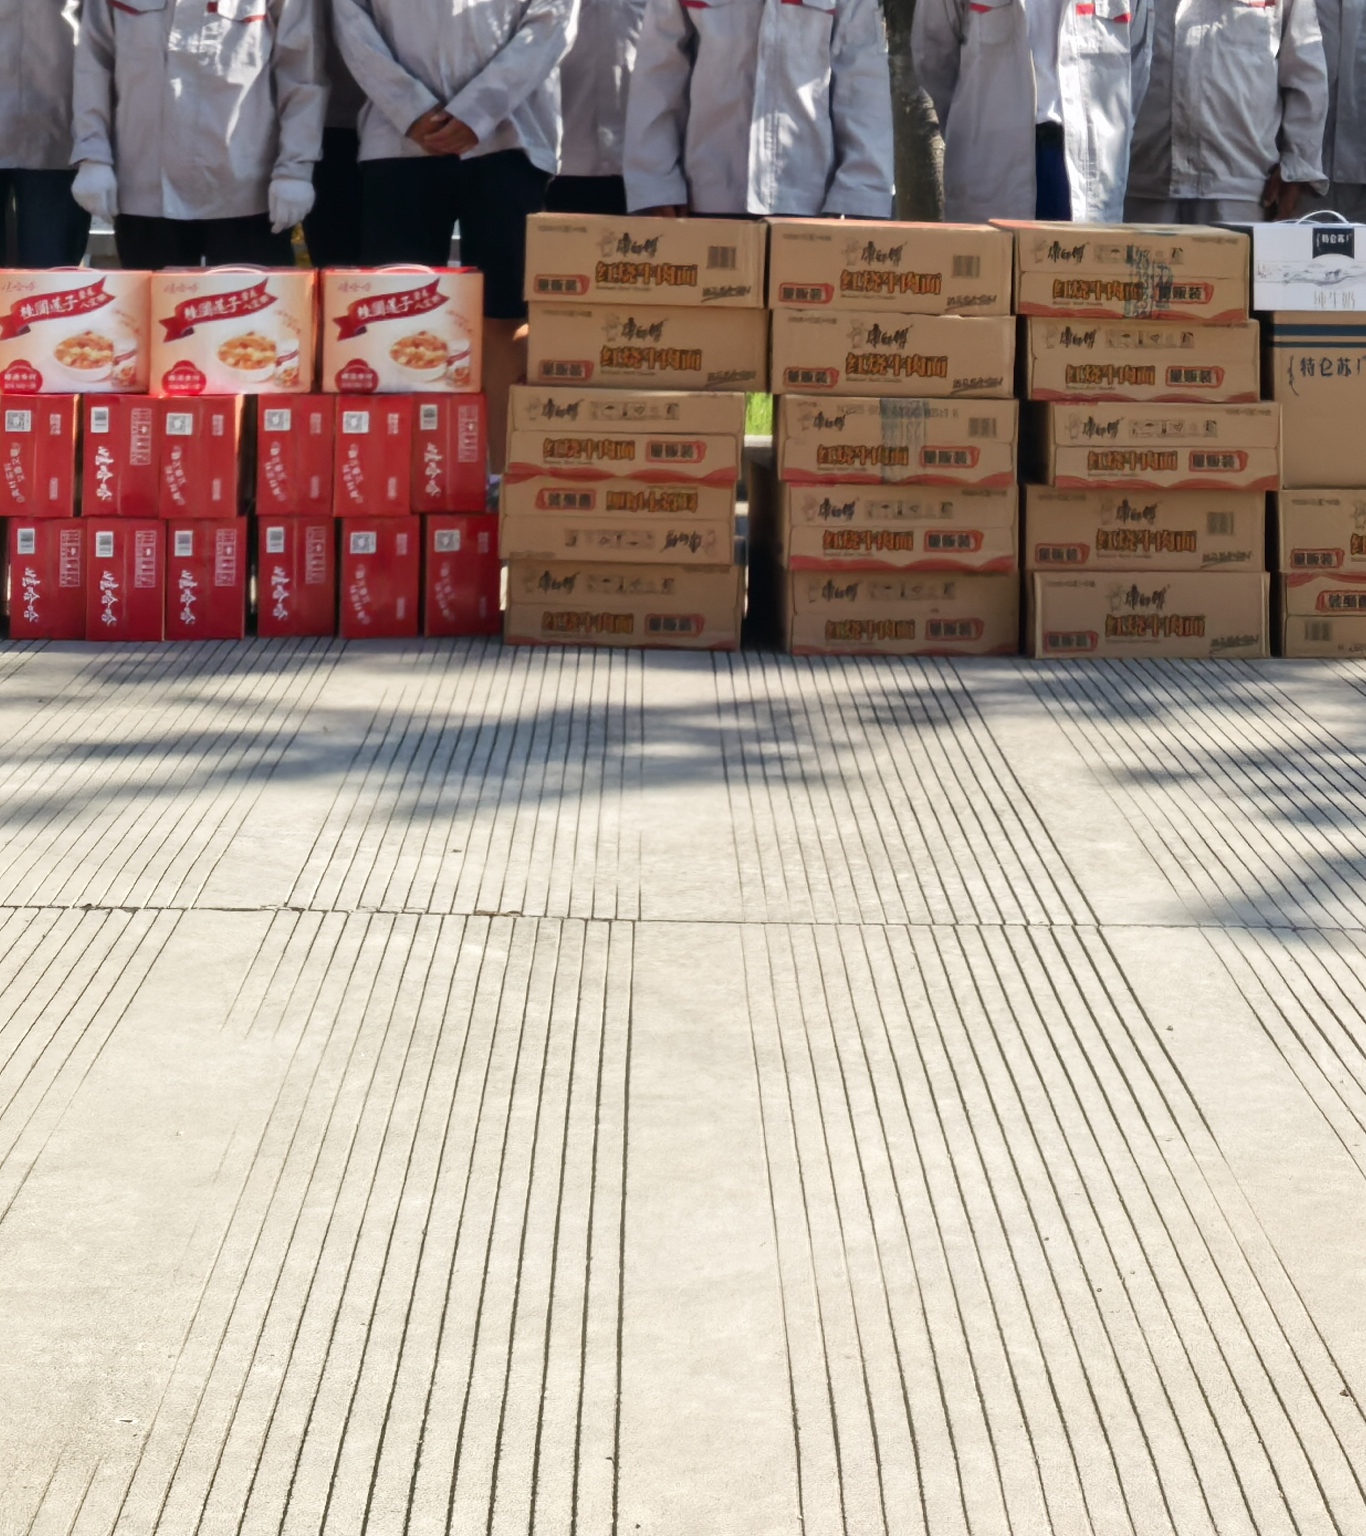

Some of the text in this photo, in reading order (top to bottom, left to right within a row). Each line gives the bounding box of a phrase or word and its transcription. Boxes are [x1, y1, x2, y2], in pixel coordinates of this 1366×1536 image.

[595, 260, 699, 287] 红烧牛肉面
[840, 268, 943, 295] 红烧牛肉面
[600, 344, 702, 371] 红烧牛肉面
[845, 352, 948, 378] 红烧牛肉面
[1300, 357, 1352, 377] 特仑苏
[1096, 528, 1197, 553] 红烧牛肉面
[1105, 613, 1206, 638] 红烧牛肉面
